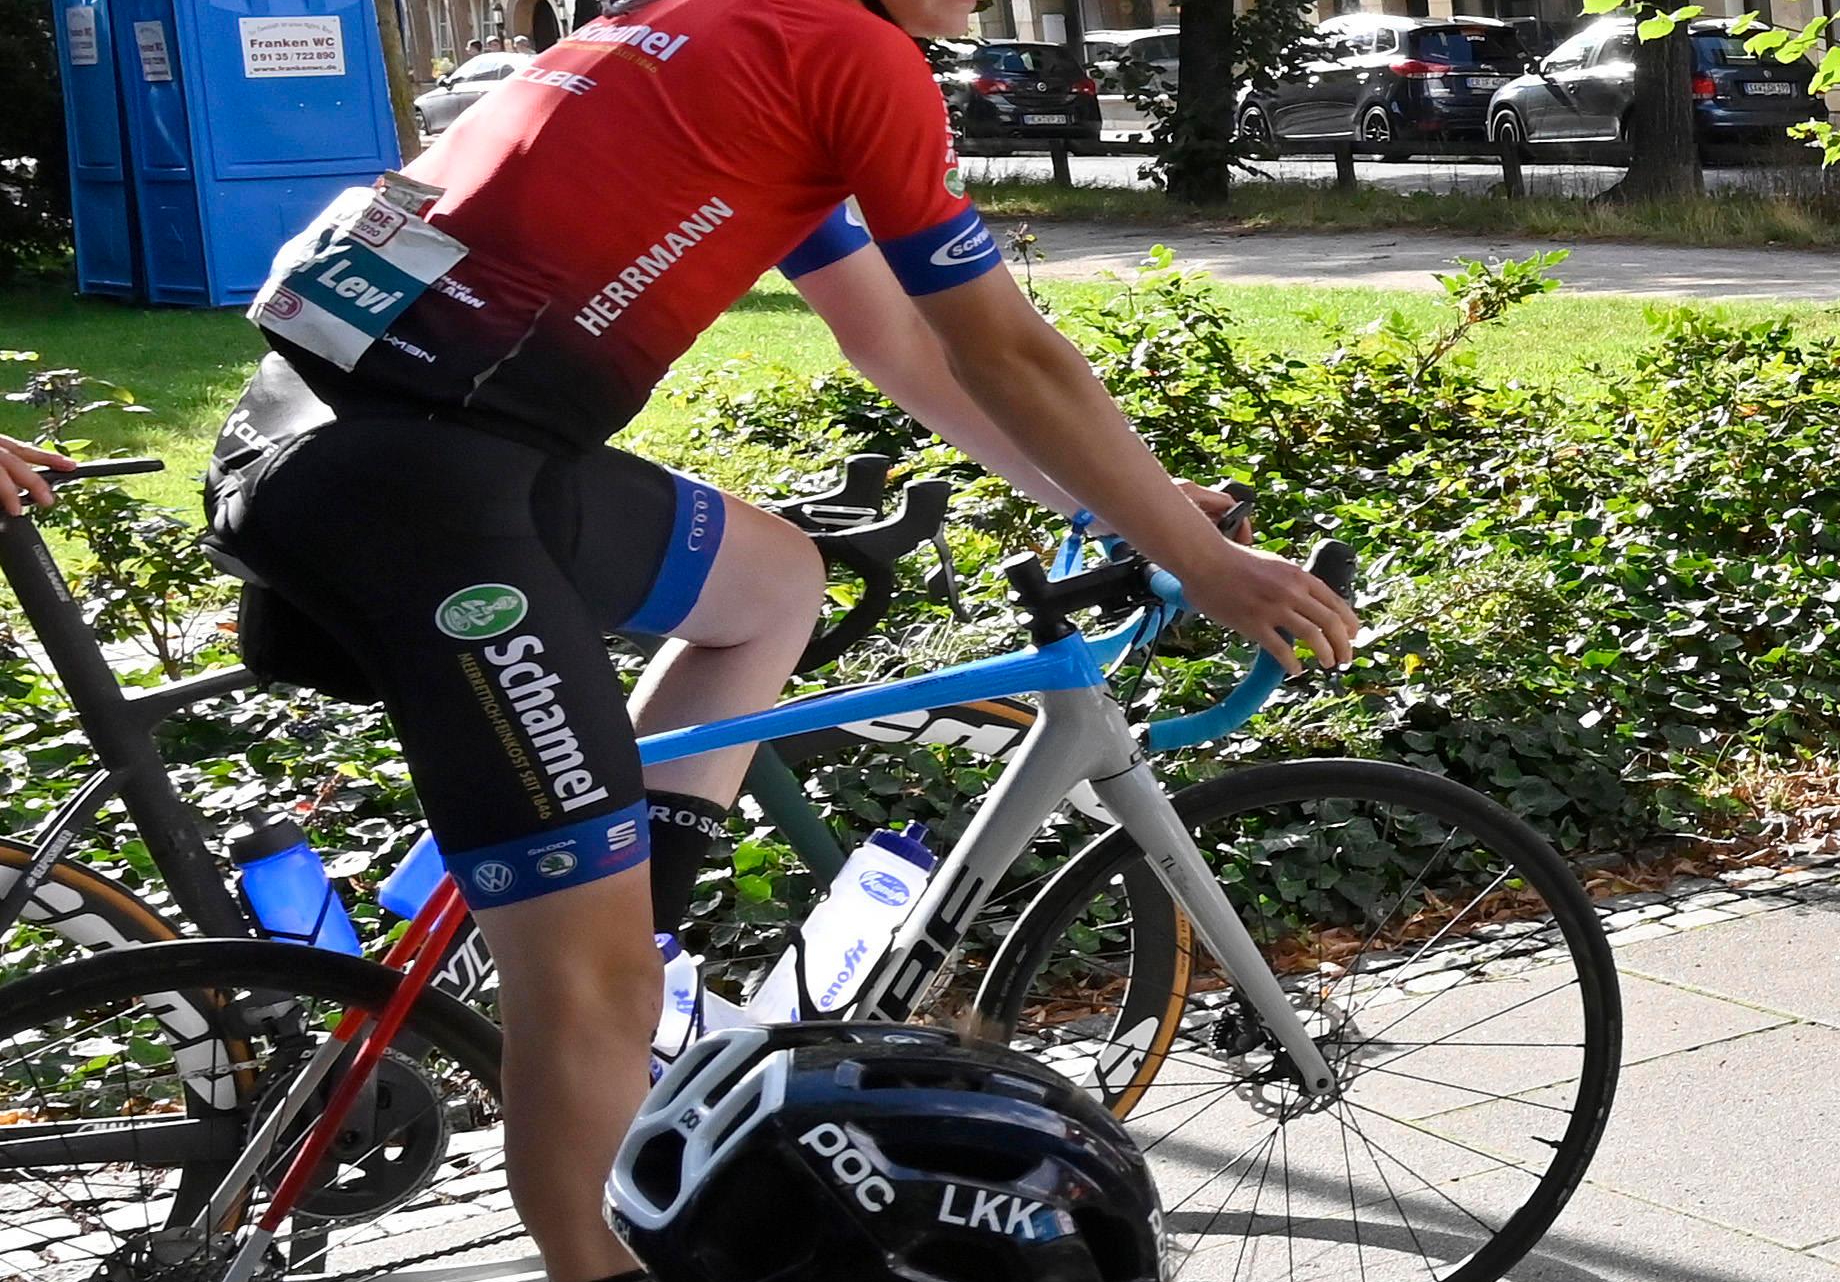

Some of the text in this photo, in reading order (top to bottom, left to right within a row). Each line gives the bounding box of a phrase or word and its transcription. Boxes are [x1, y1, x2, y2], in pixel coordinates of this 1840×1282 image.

[250, 37, 336, 49] Franken WC
[366, 205, 395, 230] IDE
[316, 259, 405, 315] Levi
[574, 196, 735, 337] HERRMANN
[484, 634, 609, 813] Schamel
[519, 769, 538, 793] SEIT
[531, 791, 554, 821] 1846
[527, 838, 578, 857] ŠKODA
[820, 939, 870, 1010] enofit
[798, 1121, 896, 1214] POC
[937, 1183, 1046, 1240] LKK
